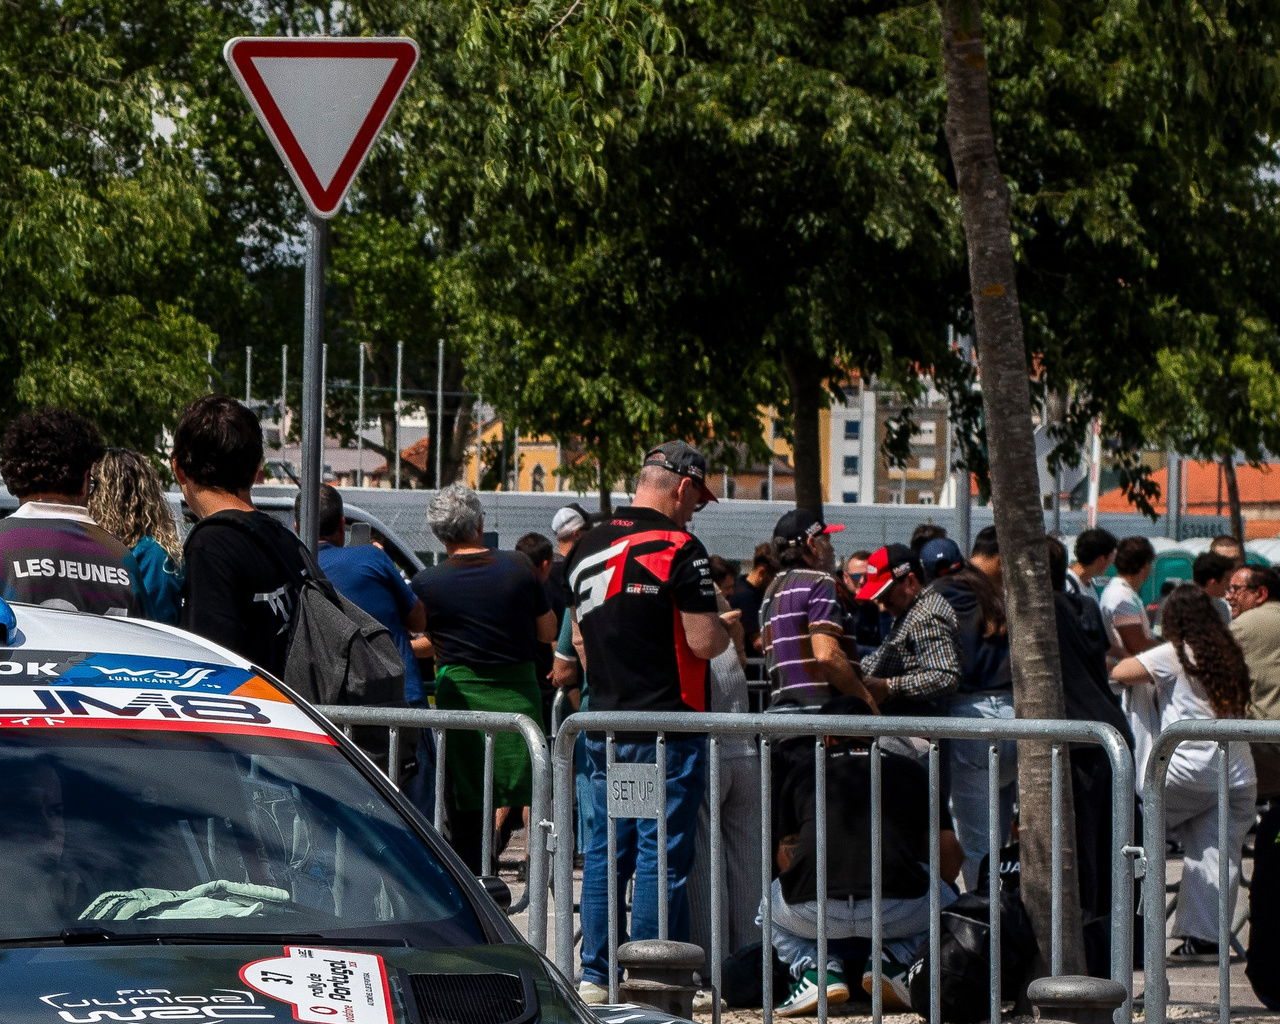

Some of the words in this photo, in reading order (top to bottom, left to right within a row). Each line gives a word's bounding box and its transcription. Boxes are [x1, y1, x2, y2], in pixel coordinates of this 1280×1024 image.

[12, 557, 55, 579] LES
[57, 561, 131, 586] JEUNES
[108, 675, 181, 686] LUBRICANTS
[612, 780, 635, 801] SET
[638, 780, 654, 801] UP
[261, 970, 294, 985] 37
